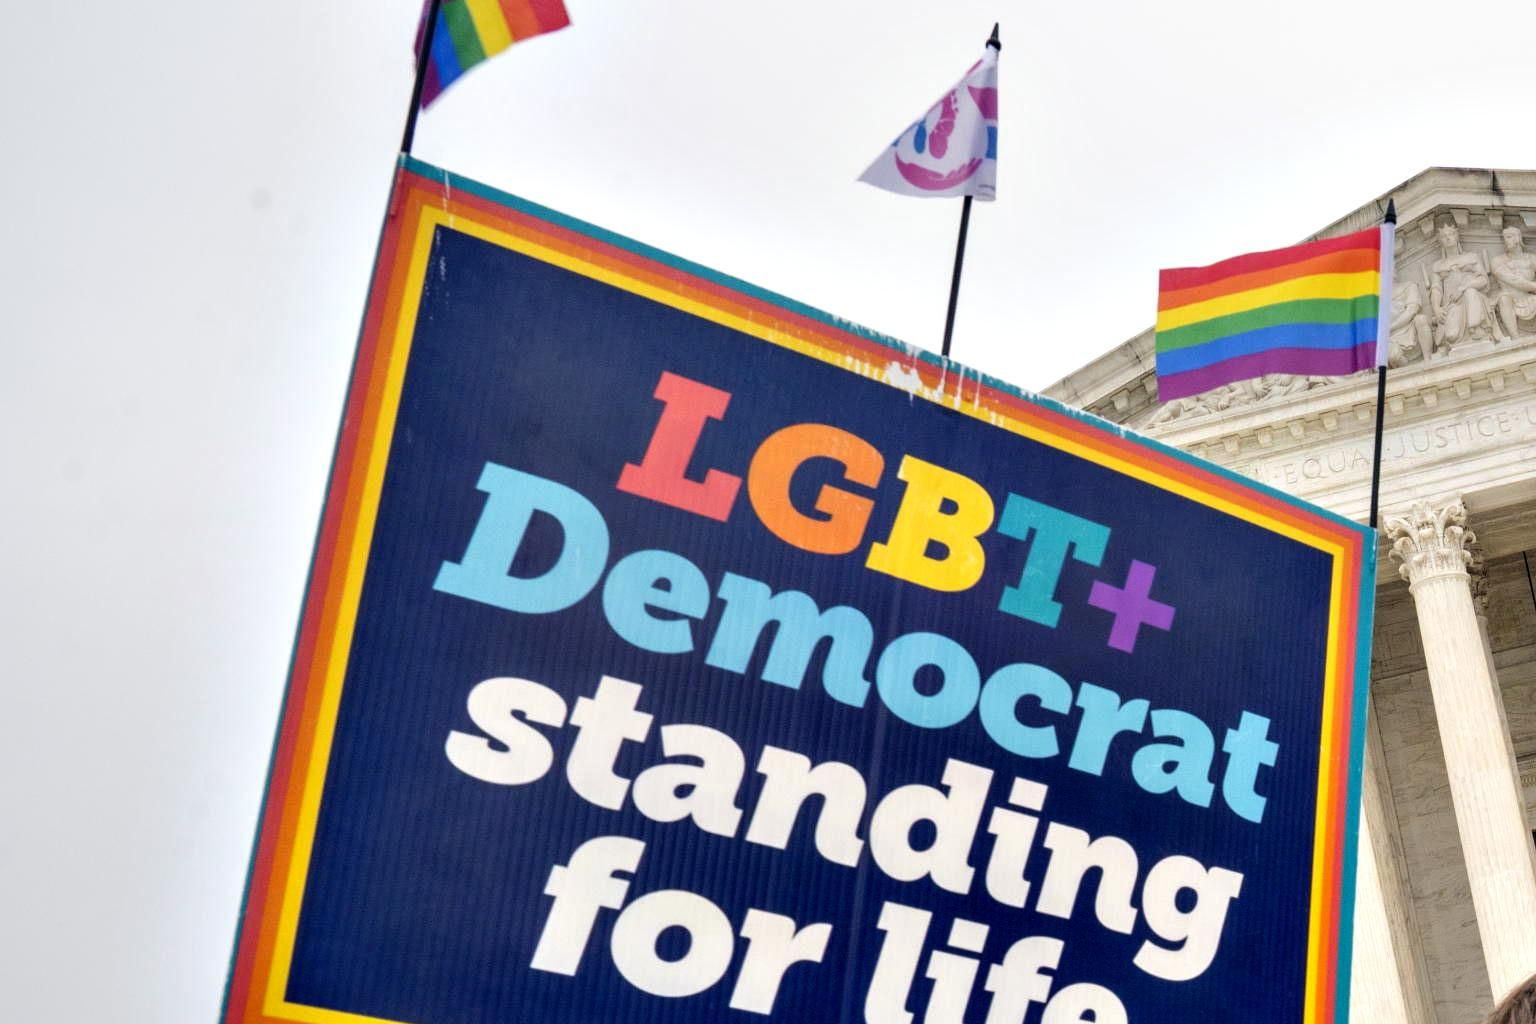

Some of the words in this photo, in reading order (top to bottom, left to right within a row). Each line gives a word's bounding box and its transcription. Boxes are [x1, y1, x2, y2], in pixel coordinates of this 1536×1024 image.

[617, 371, 1176, 654] LGBT+
[1395, 412, 1513, 459] JUSTICE
[433, 461, 1280, 823] Democrat
[445, 674, 1244, 981] standing
[530, 836, 832, 1015] for
